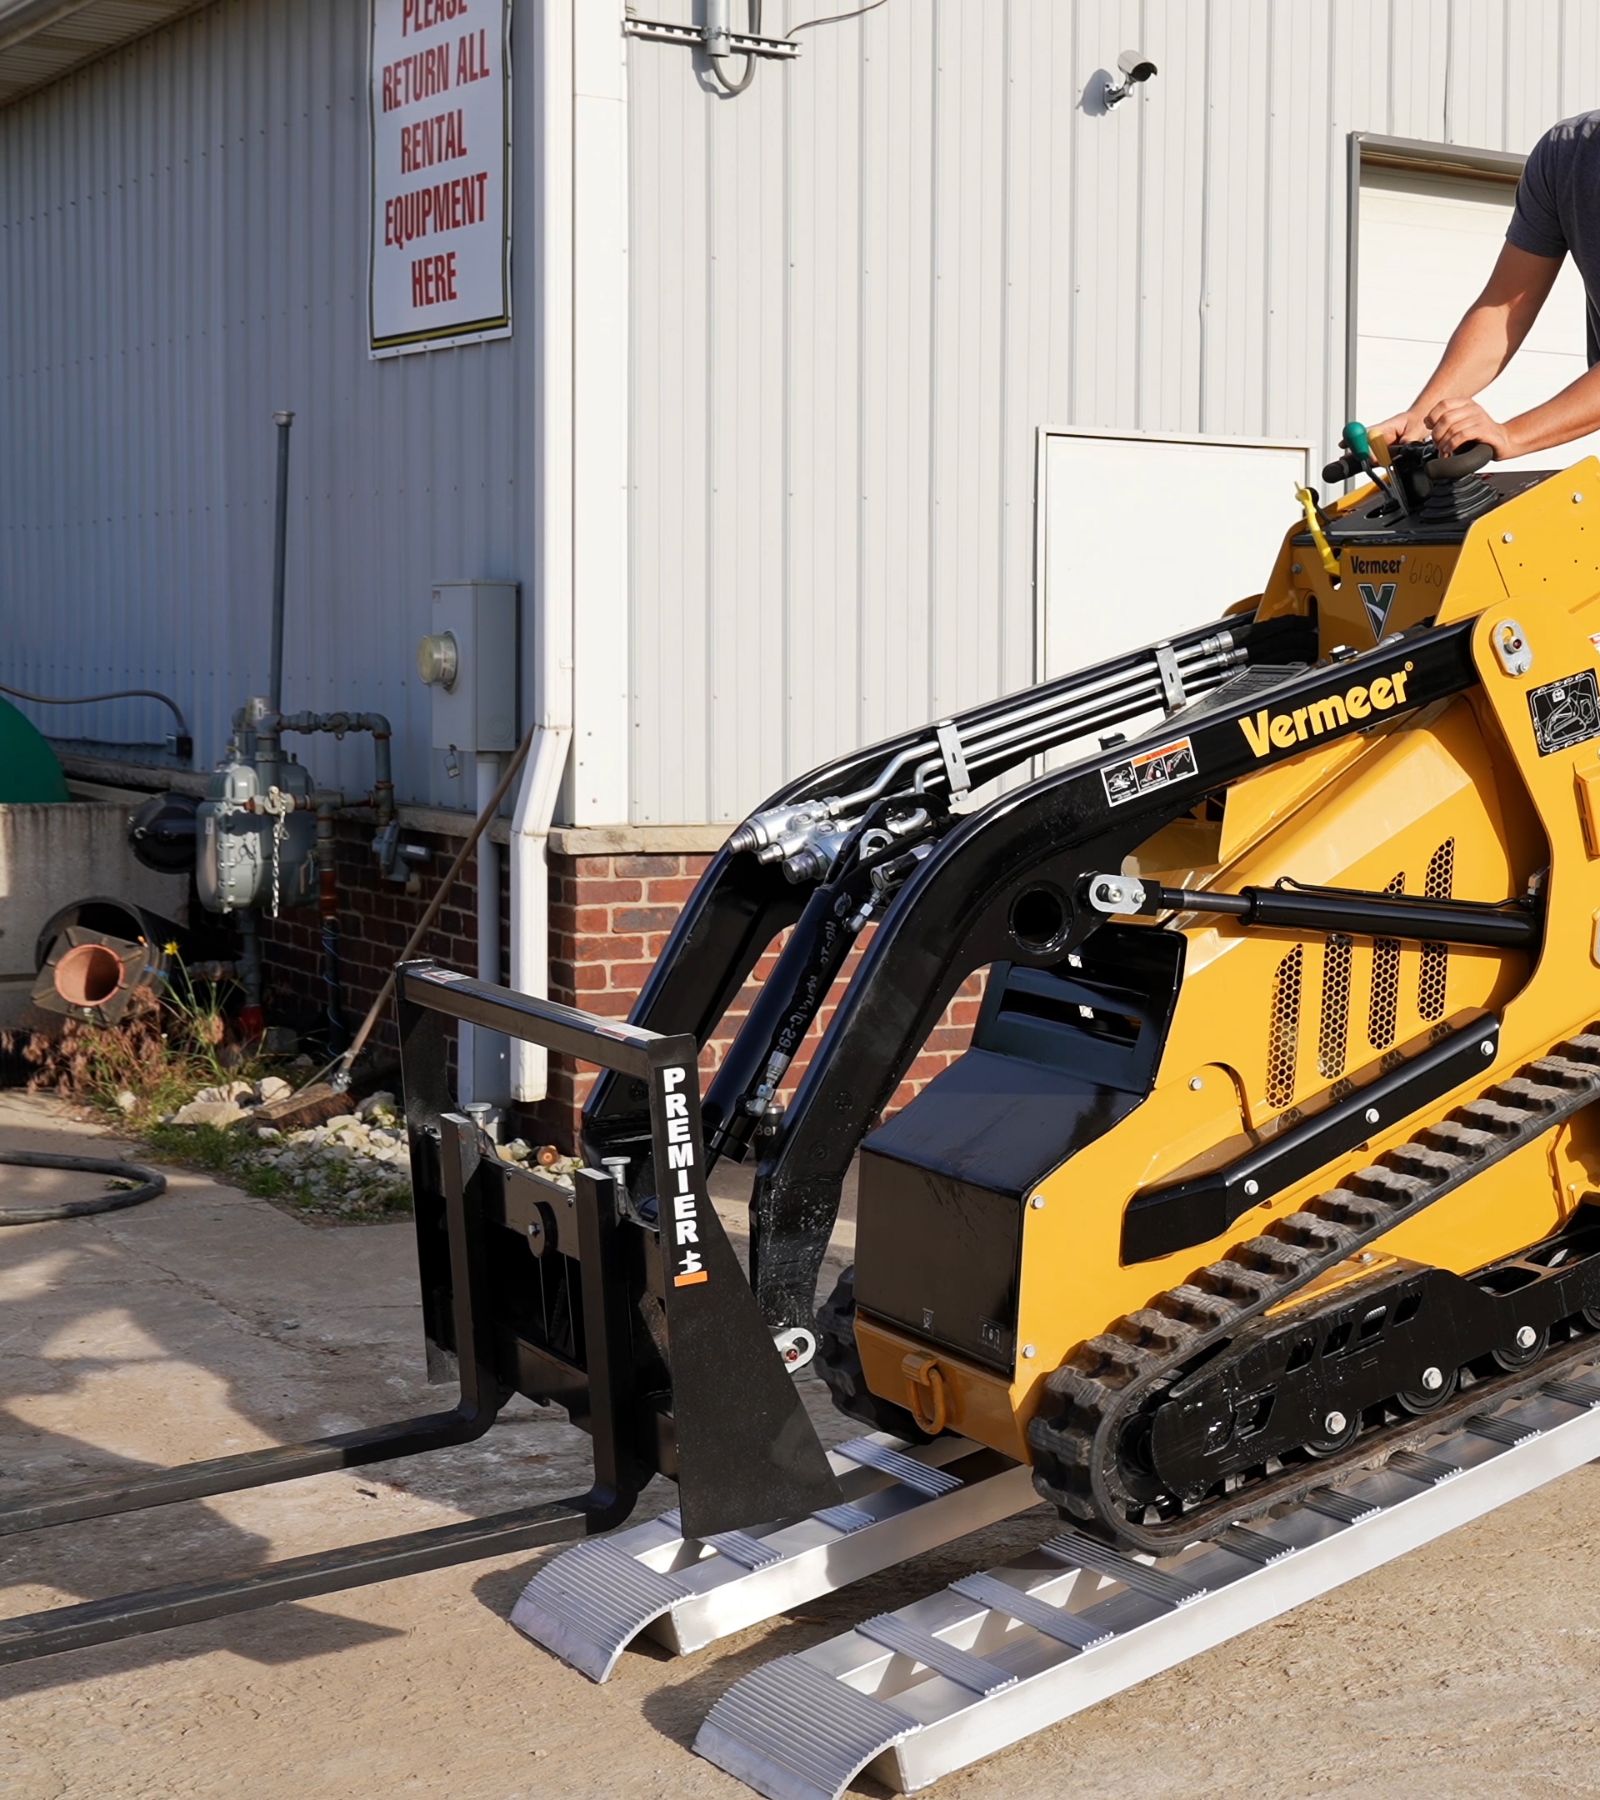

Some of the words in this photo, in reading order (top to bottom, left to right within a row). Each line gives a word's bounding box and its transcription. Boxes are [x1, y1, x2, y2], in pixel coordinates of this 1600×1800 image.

[382, 42, 450, 114] RETURN
[456, 28, 490, 87] ALL
[401, 109, 468, 175] RENTAL
[385, 172, 488, 250] EQUIPMENT
[411, 252, 458, 308] HERE
[1350, 555, 1401, 575] Vermeer
[1238, 669, 1408, 758] Vermeer
[663, 1067, 700, 1246] PREMIER
